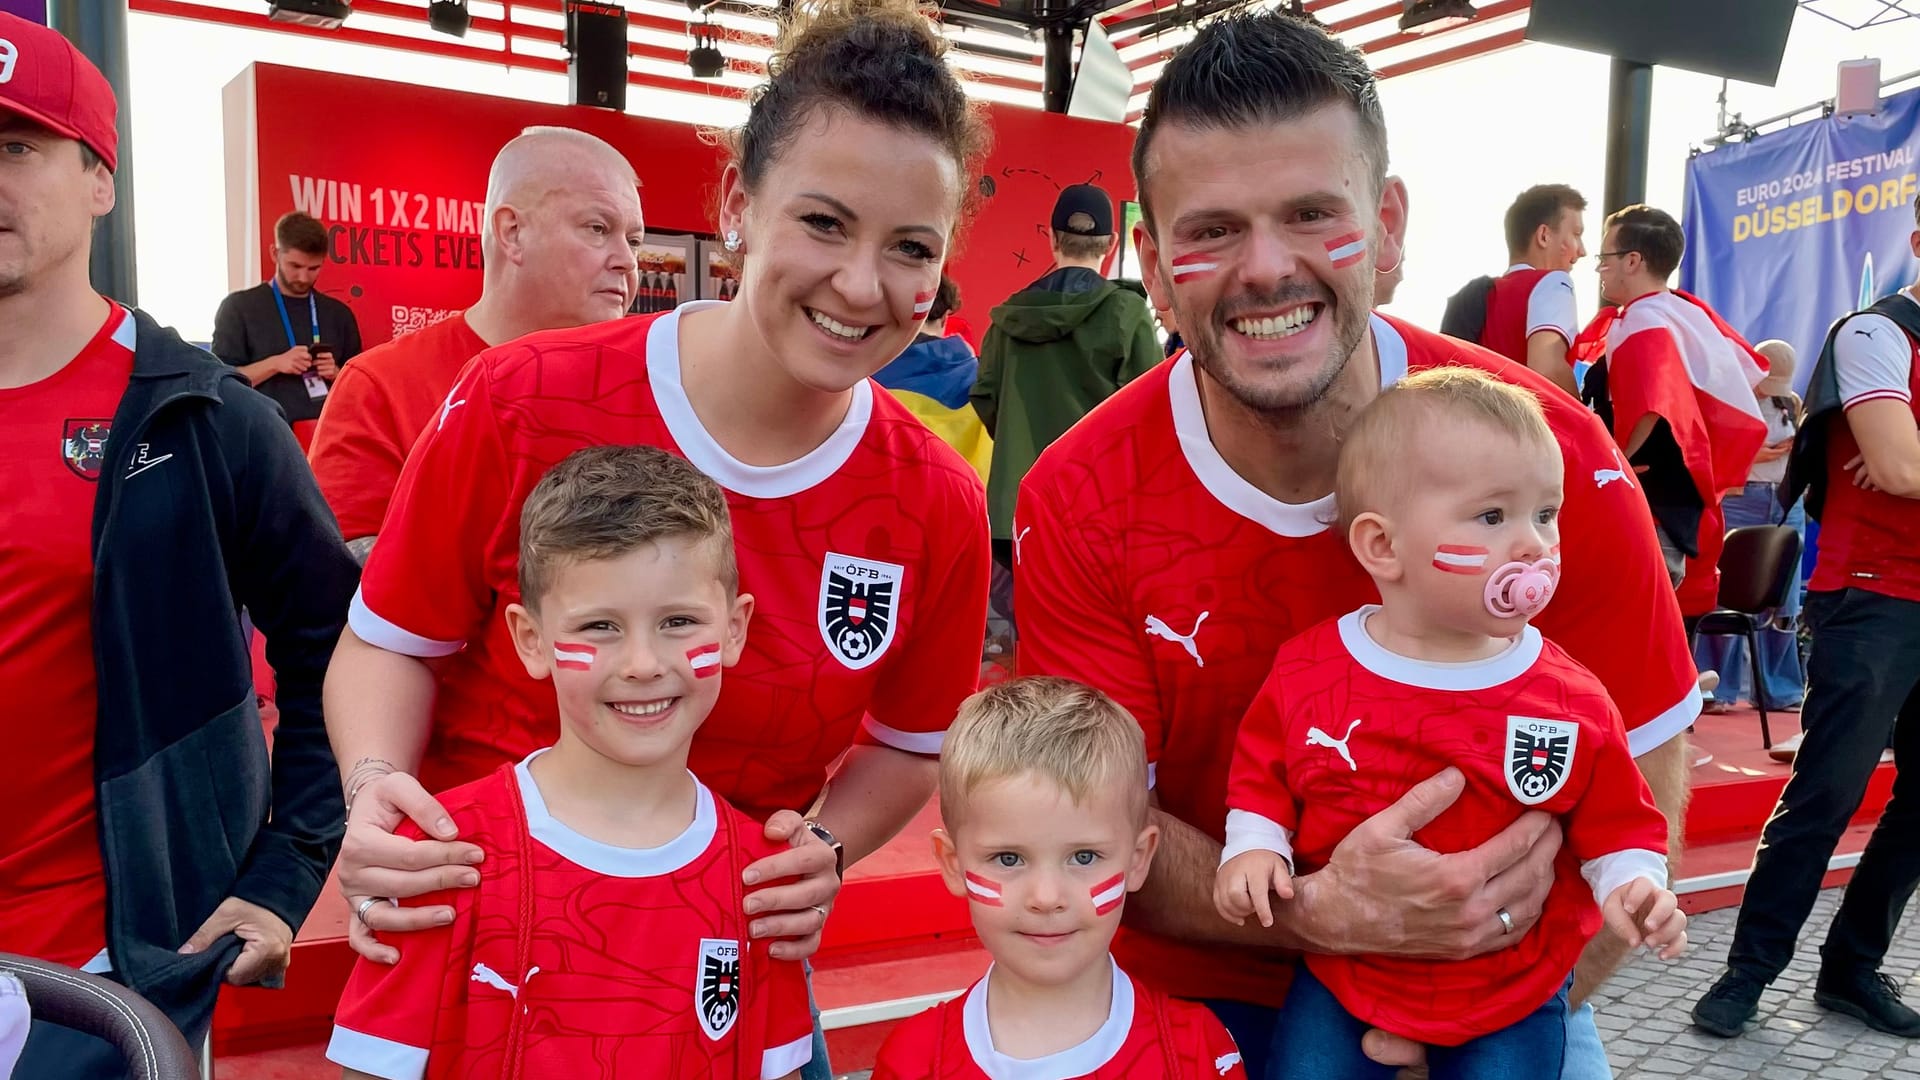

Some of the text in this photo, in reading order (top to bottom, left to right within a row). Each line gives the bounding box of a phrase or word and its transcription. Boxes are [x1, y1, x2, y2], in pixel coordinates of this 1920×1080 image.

[290, 174, 362, 223] WIN
[1737, 146, 1914, 207] EURO 2024 FESTIVAL
[1733, 173, 1917, 242] DÜSSELDORF
[328, 224, 485, 270] CKETS EVE
[846, 563, 880, 579] ÖFB
[1528, 722, 1557, 734] ÖFB
[716, 945, 738, 957] ÖFB
